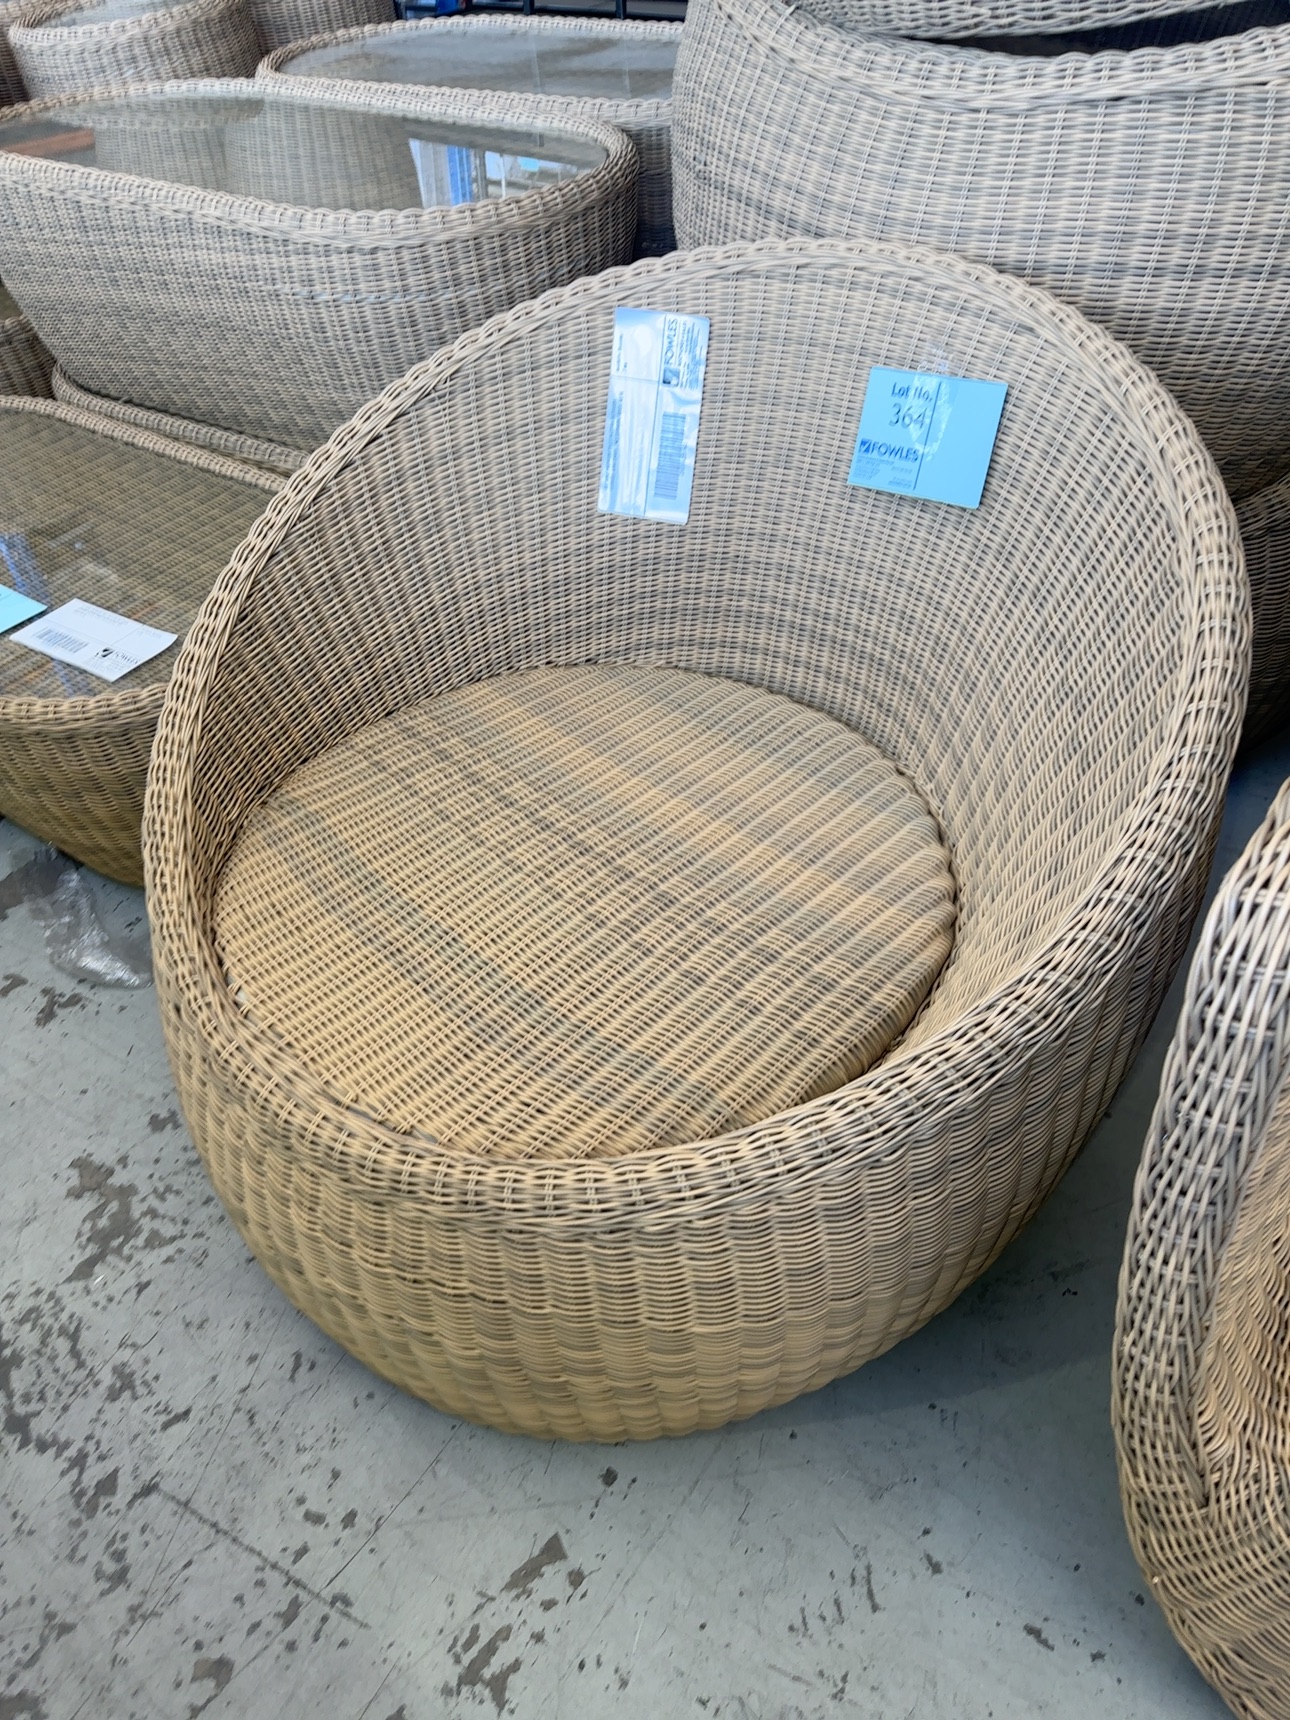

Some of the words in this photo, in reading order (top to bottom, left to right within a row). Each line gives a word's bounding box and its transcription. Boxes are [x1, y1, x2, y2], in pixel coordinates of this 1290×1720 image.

[664, 318, 678, 366] FOWLES
[891, 382, 910, 398] Lot
[888, 403, 927, 430] 364
[870, 441, 919, 463] FOWLES
